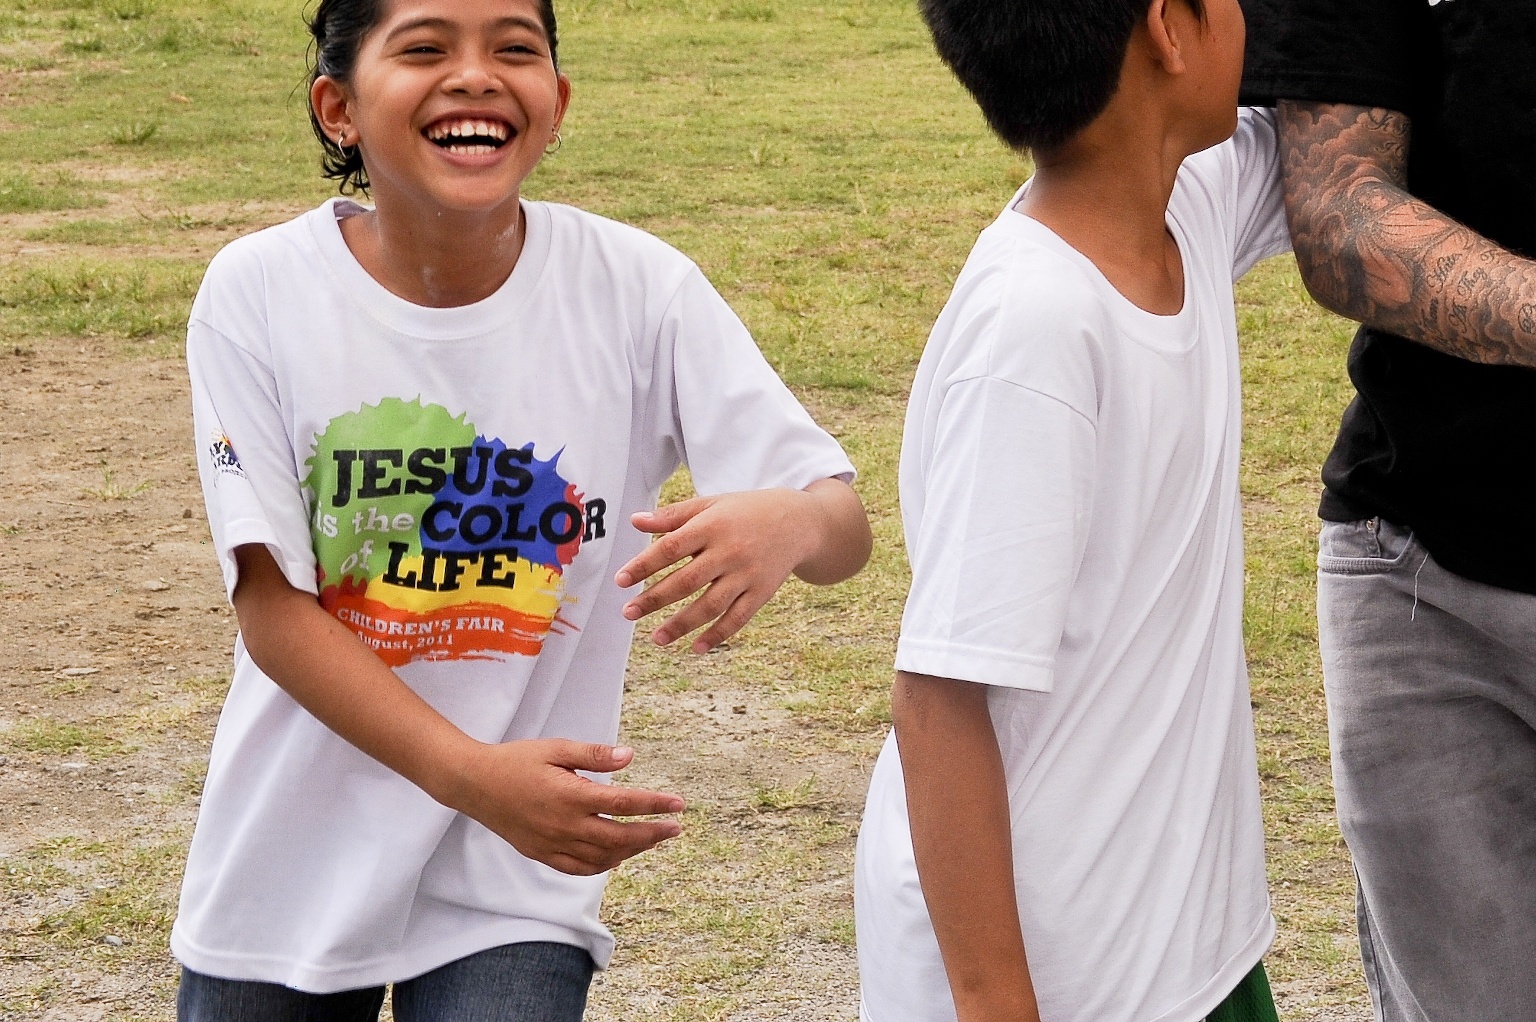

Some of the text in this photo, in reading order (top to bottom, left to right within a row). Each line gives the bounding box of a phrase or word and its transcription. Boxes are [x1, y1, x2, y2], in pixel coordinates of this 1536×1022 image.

[332, 446, 534, 507] JESUS
[316, 498, 608, 545] is the COLOR
[340, 539, 374, 575] of
[381, 541, 519, 592] LIFE
[336, 607, 505, 636] CHILDREN'S FAIR
[357, 631, 453, 651] August, 2011
